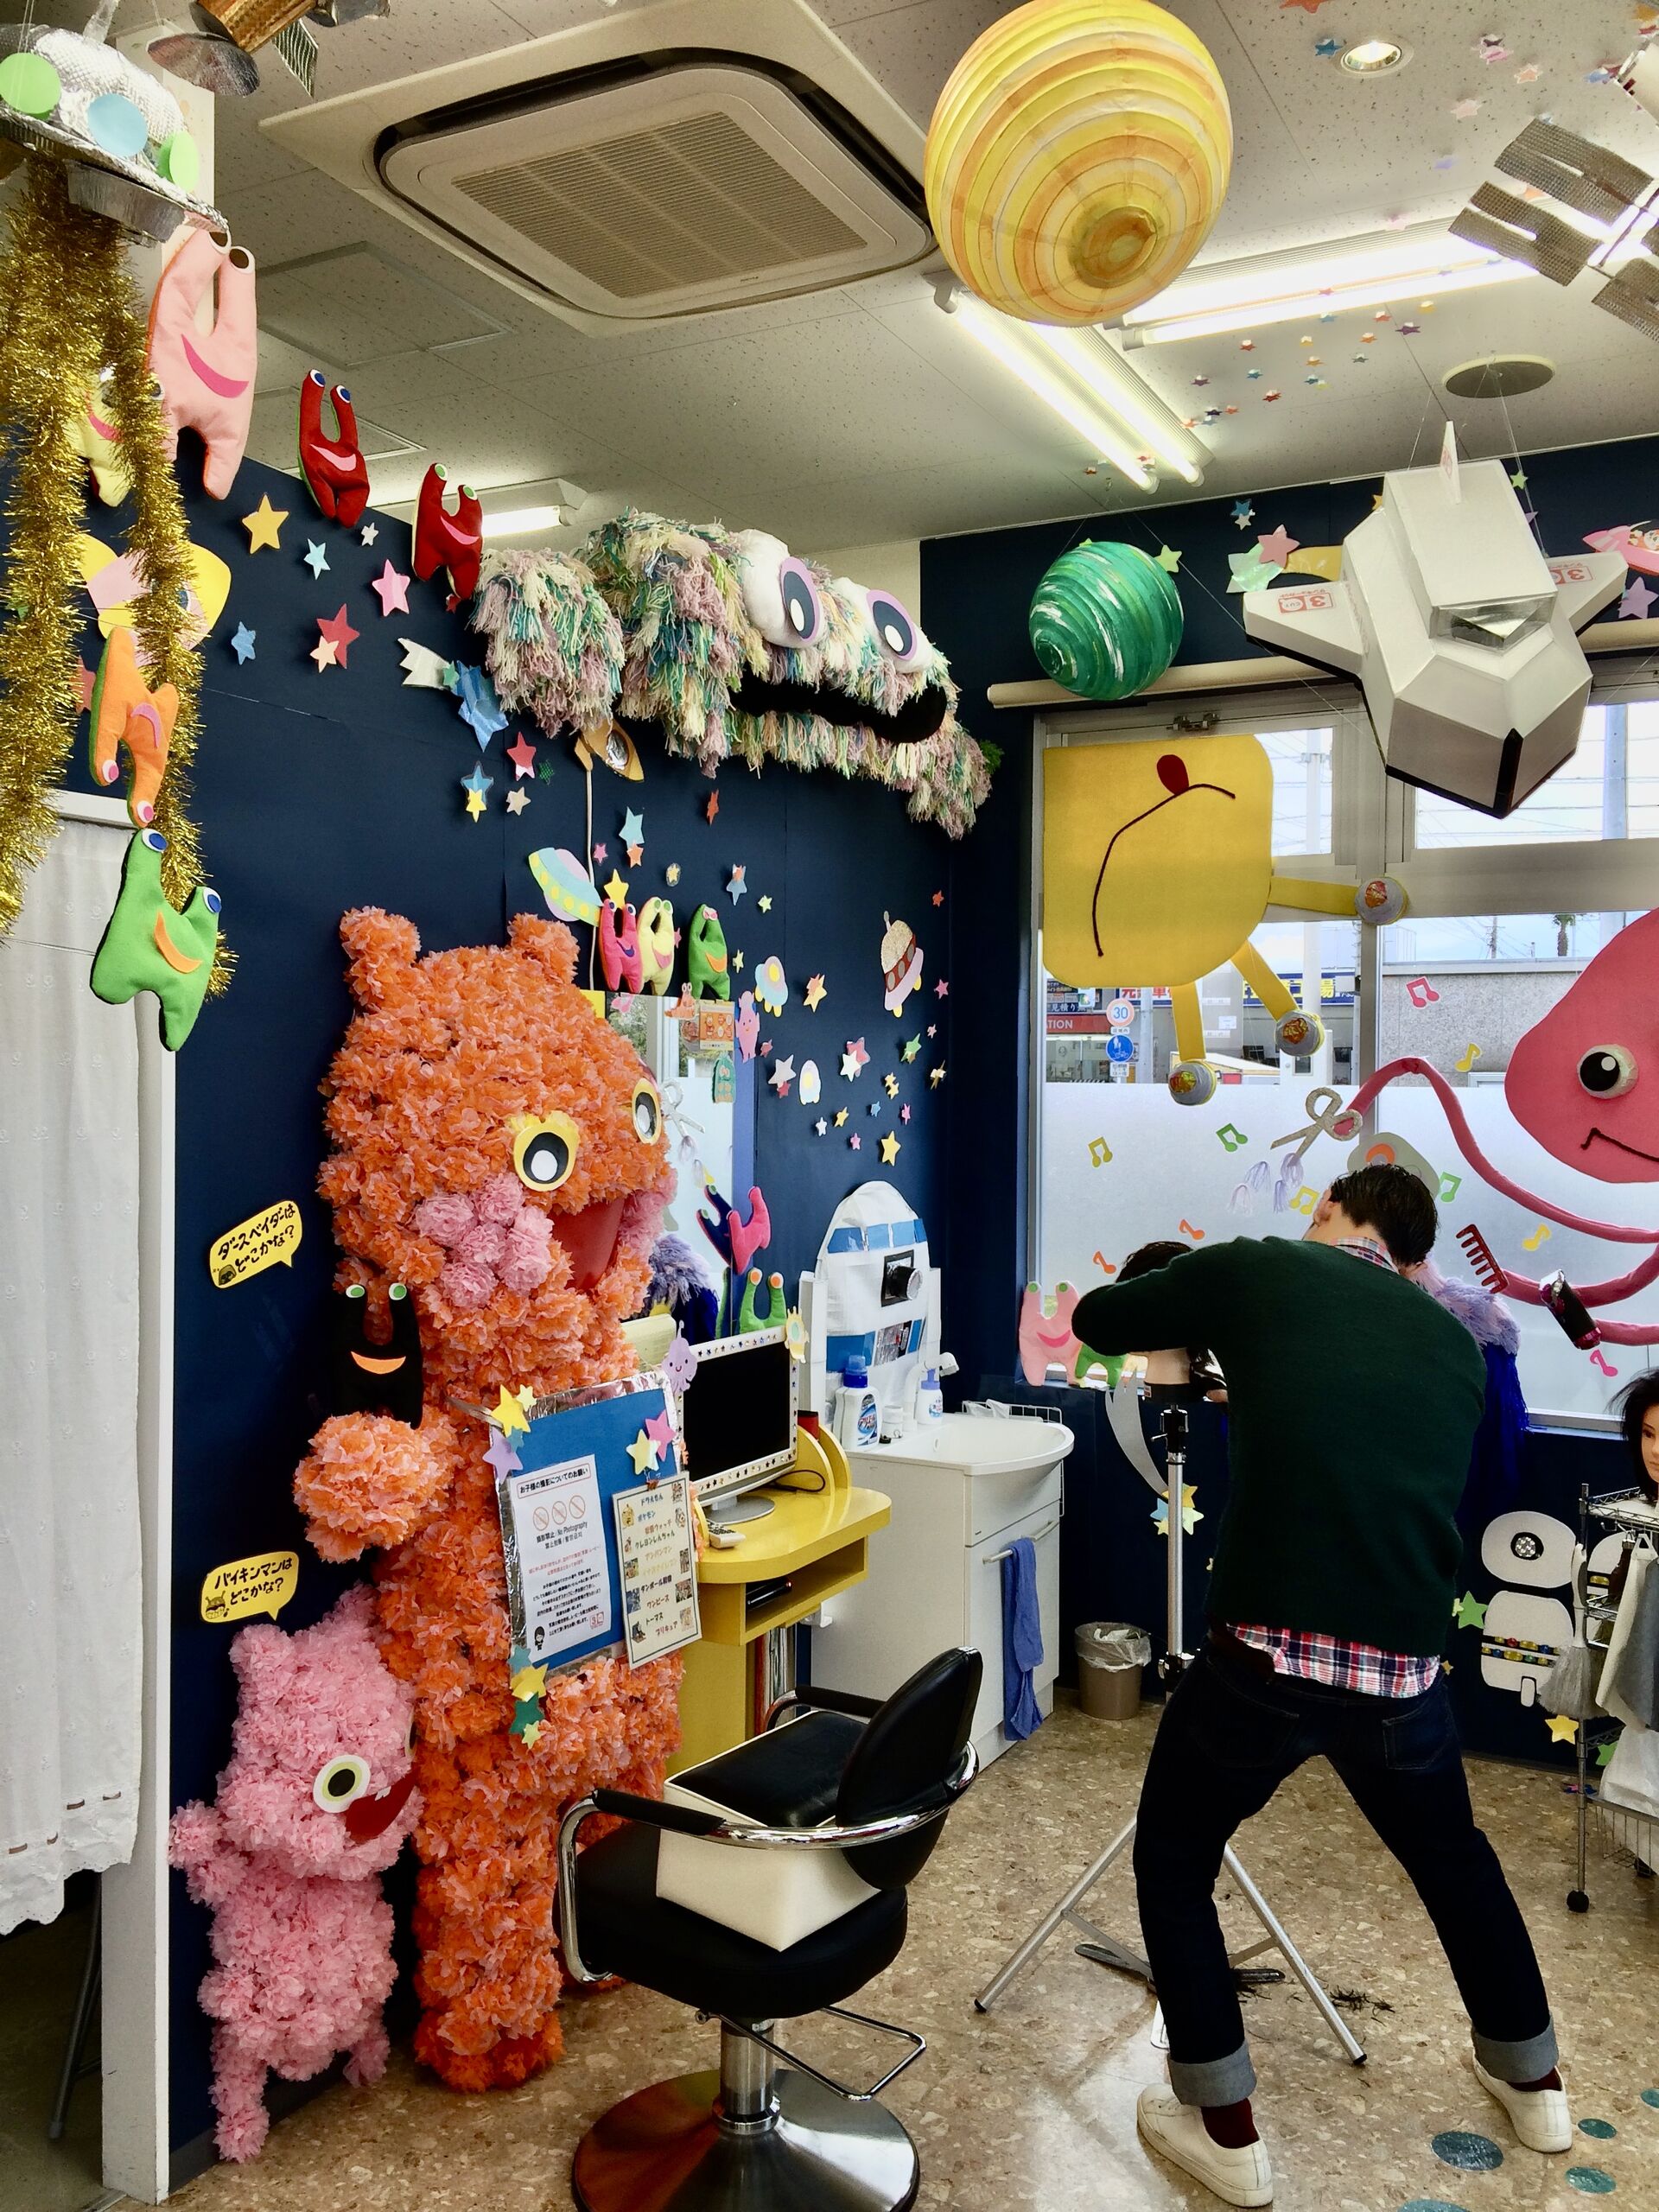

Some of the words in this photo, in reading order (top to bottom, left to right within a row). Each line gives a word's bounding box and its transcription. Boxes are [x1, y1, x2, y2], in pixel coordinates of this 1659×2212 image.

[1309, 595, 1326, 607] 3
[1046, 1020, 1073, 1029] TION
[1114, 1007, 1128, 1019] 30
[218, 1204, 296, 1260] ダースベイダーは
[234, 1224, 295, 1273] どこかな?
[214, 1558, 292, 1590] バイキンマンは
[230, 1577, 284, 1605] どこかな?
